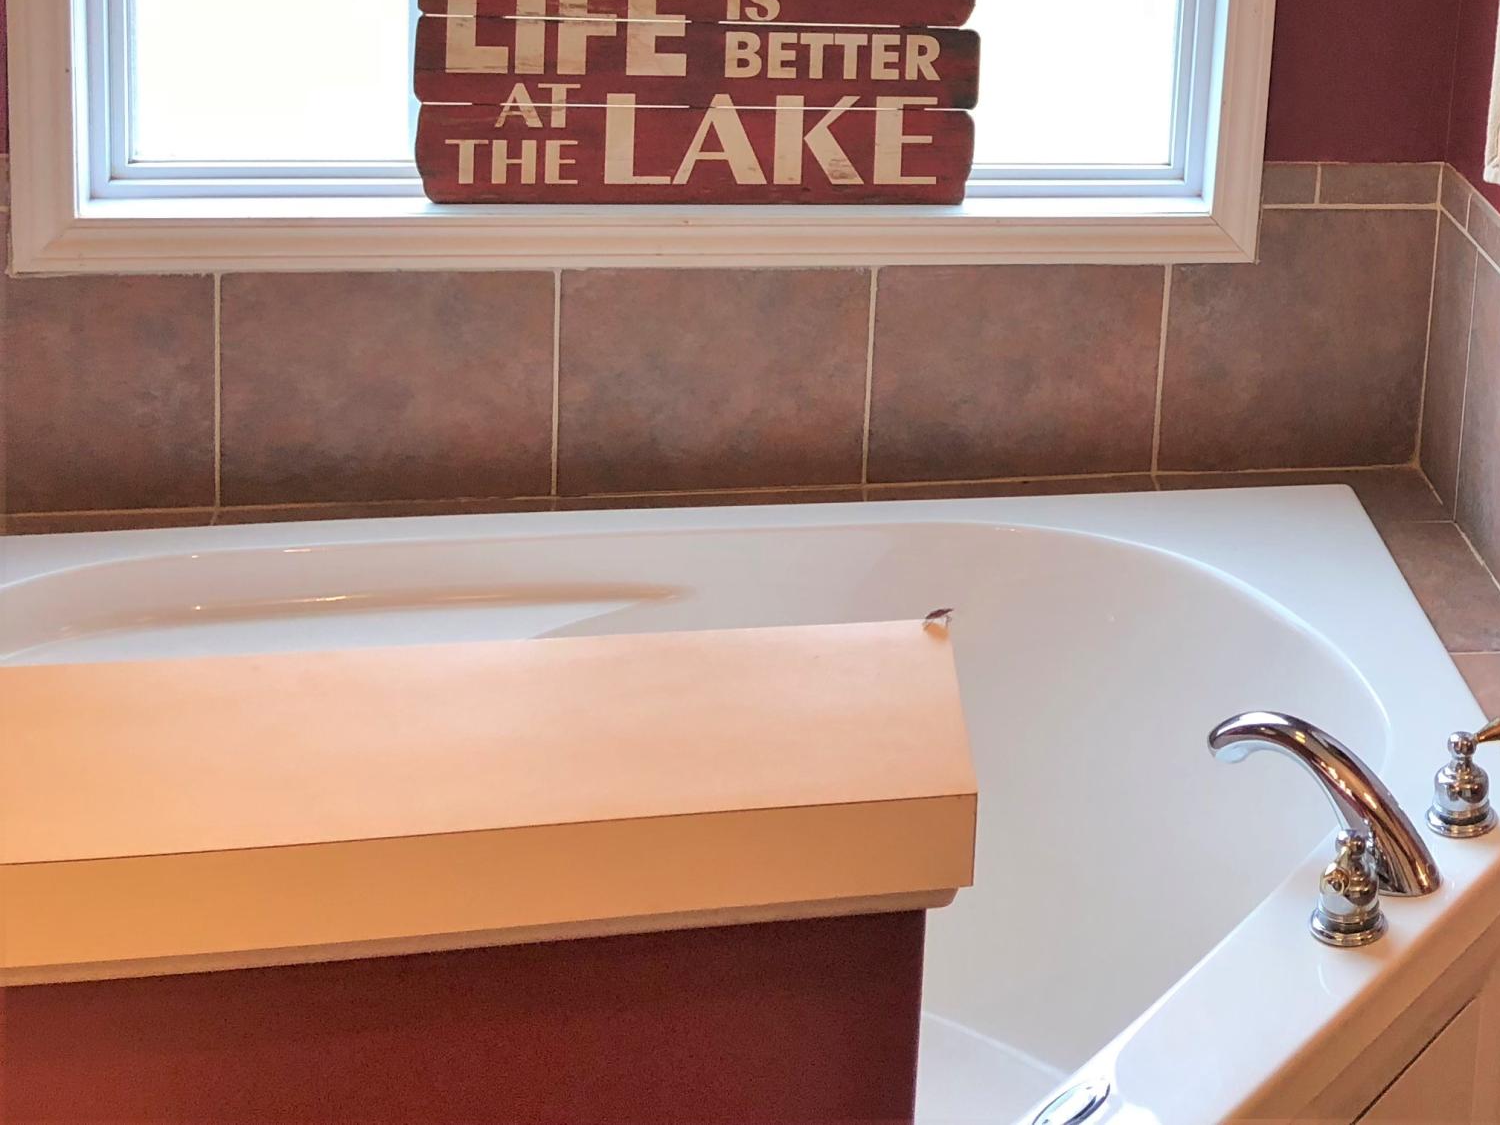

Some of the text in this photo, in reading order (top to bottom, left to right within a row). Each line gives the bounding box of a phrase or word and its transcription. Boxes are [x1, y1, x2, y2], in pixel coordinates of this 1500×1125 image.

[724, 31, 941, 81] BETTER
[494, 83, 581, 129] AT
[445, 93, 938, 185] THE LAKE
